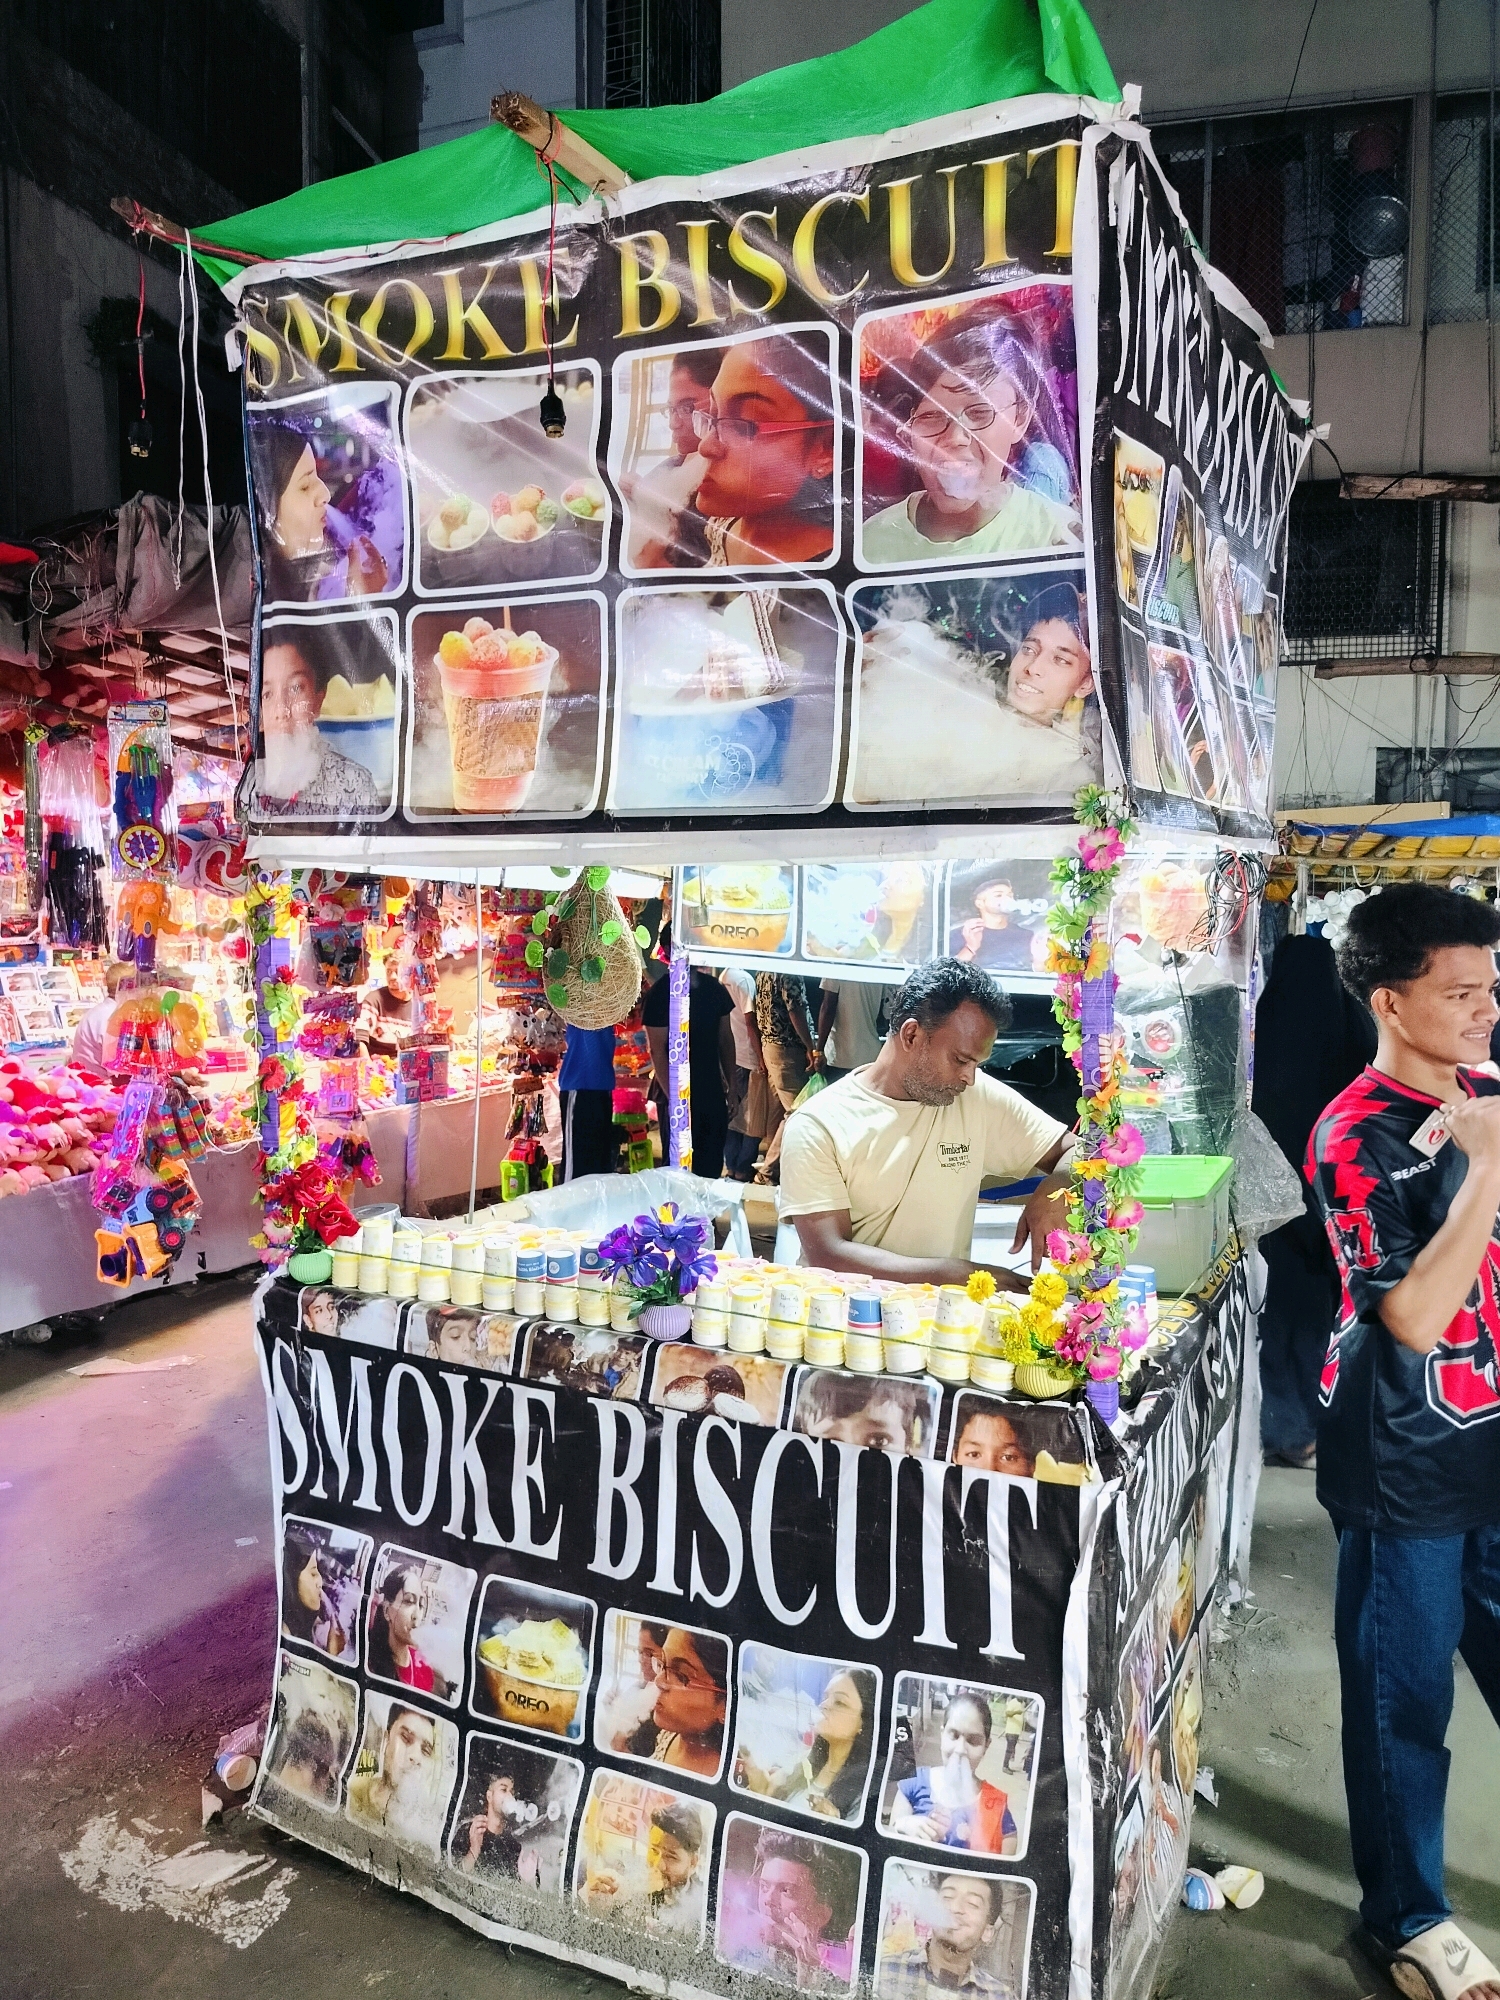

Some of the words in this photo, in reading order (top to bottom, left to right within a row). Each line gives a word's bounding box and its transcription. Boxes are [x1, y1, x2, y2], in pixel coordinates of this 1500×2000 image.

[243, 247, 580, 394] SMOKE
[610, 138, 1081, 339] BISCUIT
[710, 924, 760, 940] OREO
[1390, 1156, 1437, 1181] BEAST
[272, 1336, 564, 1561] SMOKE
[586, 1396, 1039, 1661] BISCUIT
[504, 1690, 550, 1713] OREO
[1440, 1937, 1467, 1957] NIKE
